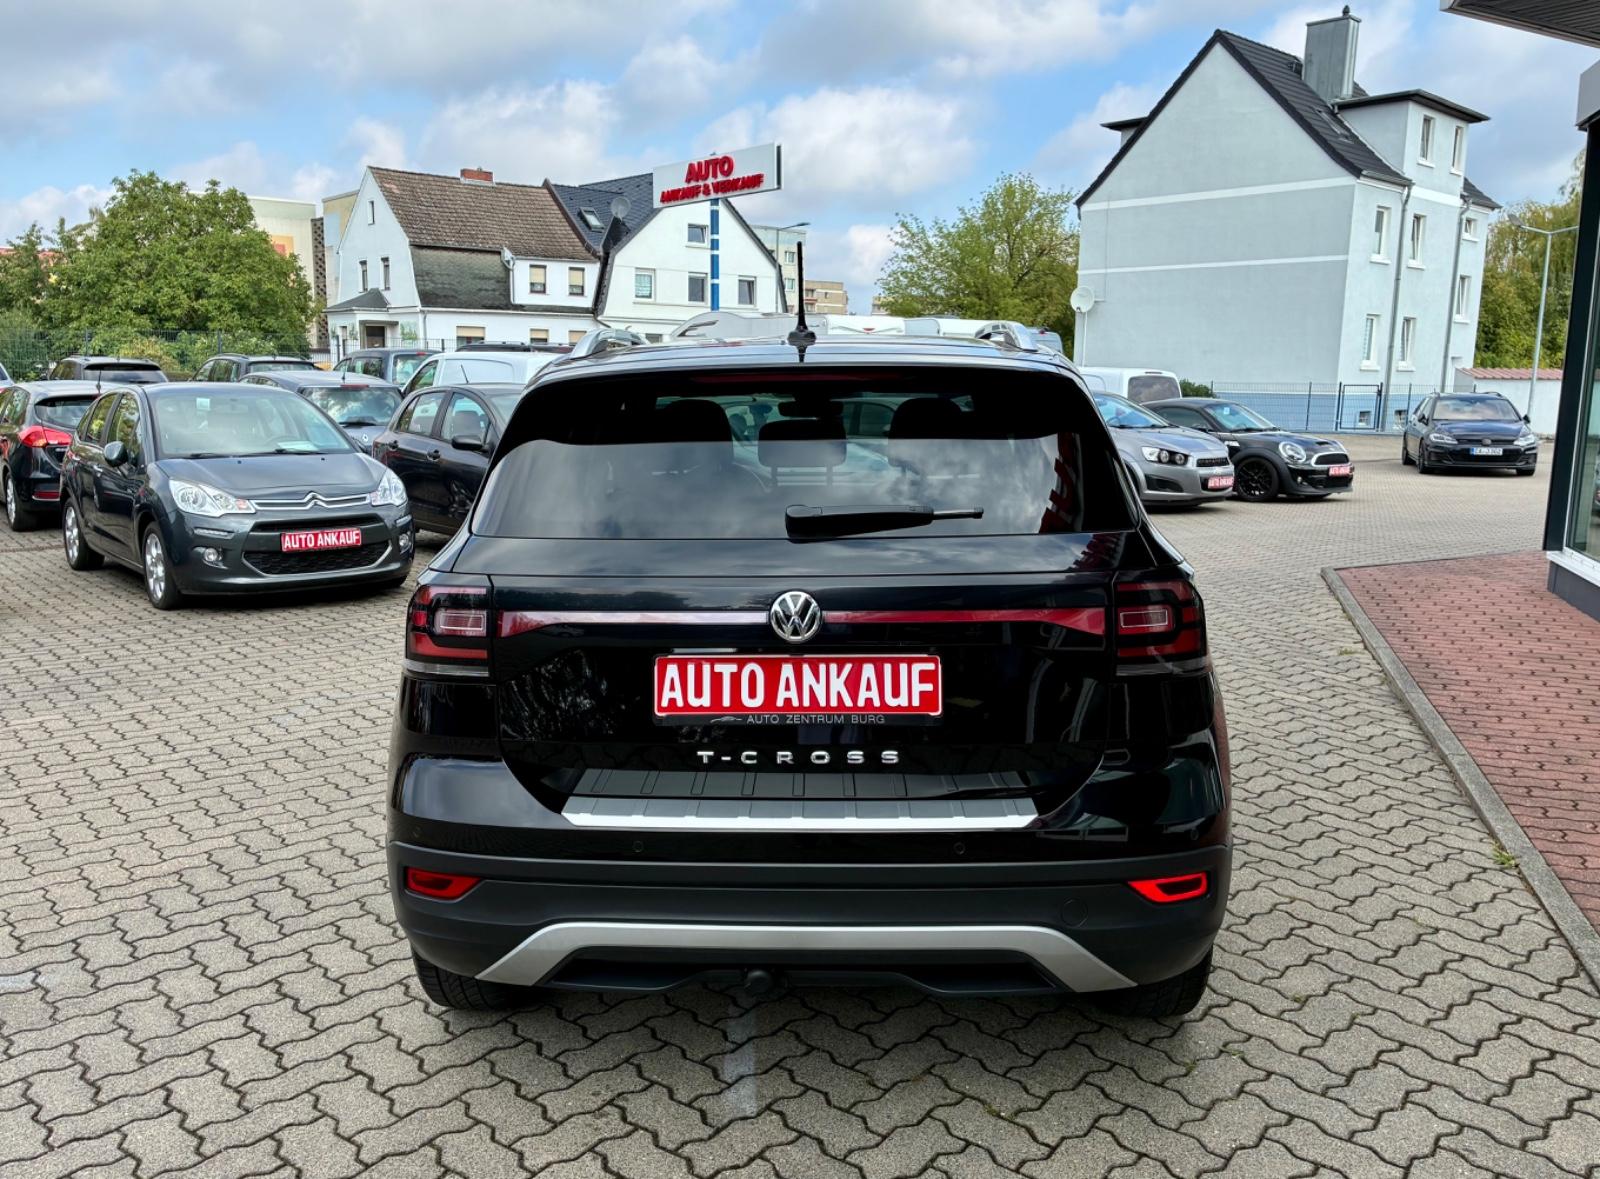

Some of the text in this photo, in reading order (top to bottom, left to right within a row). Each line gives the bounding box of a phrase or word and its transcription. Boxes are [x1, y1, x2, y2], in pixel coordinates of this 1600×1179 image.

[685, 156, 733, 183] AUTO
[702, 184, 711, 196] &
[284, 530, 360, 549] AUTO ANKAUF
[660, 662, 936, 707] AUTO ANKAUF
[746, 714, 885, 724] AUTO ZENTRUM BURG
[697, 751, 899, 764] T-CROSS
